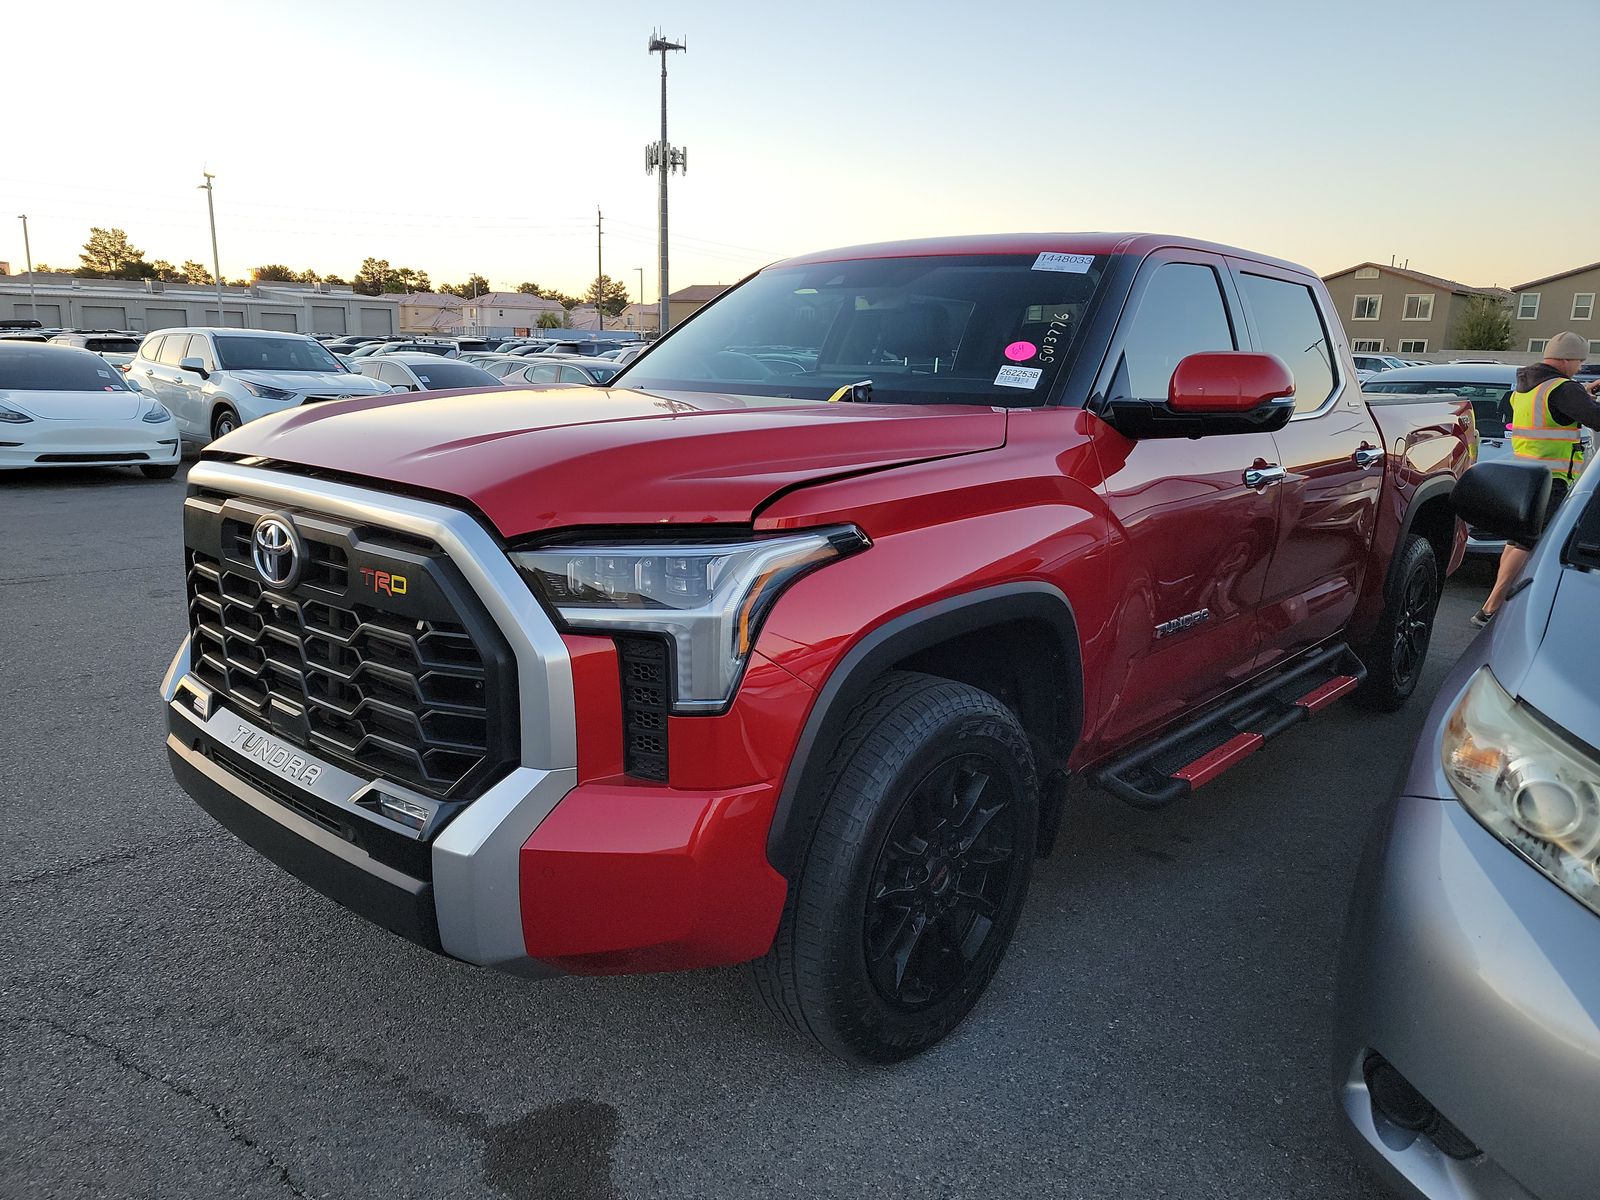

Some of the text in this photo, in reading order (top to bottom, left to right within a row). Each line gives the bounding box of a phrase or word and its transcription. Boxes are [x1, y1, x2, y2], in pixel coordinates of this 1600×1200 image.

[1041, 254, 1093, 264] 1448033
[1039, 313, 1069, 363] 5013776
[360, 567, 407, 597] TRD
[1153, 607, 1209, 639] TUNDRA
[231, 725, 323, 786] TUNDRA
